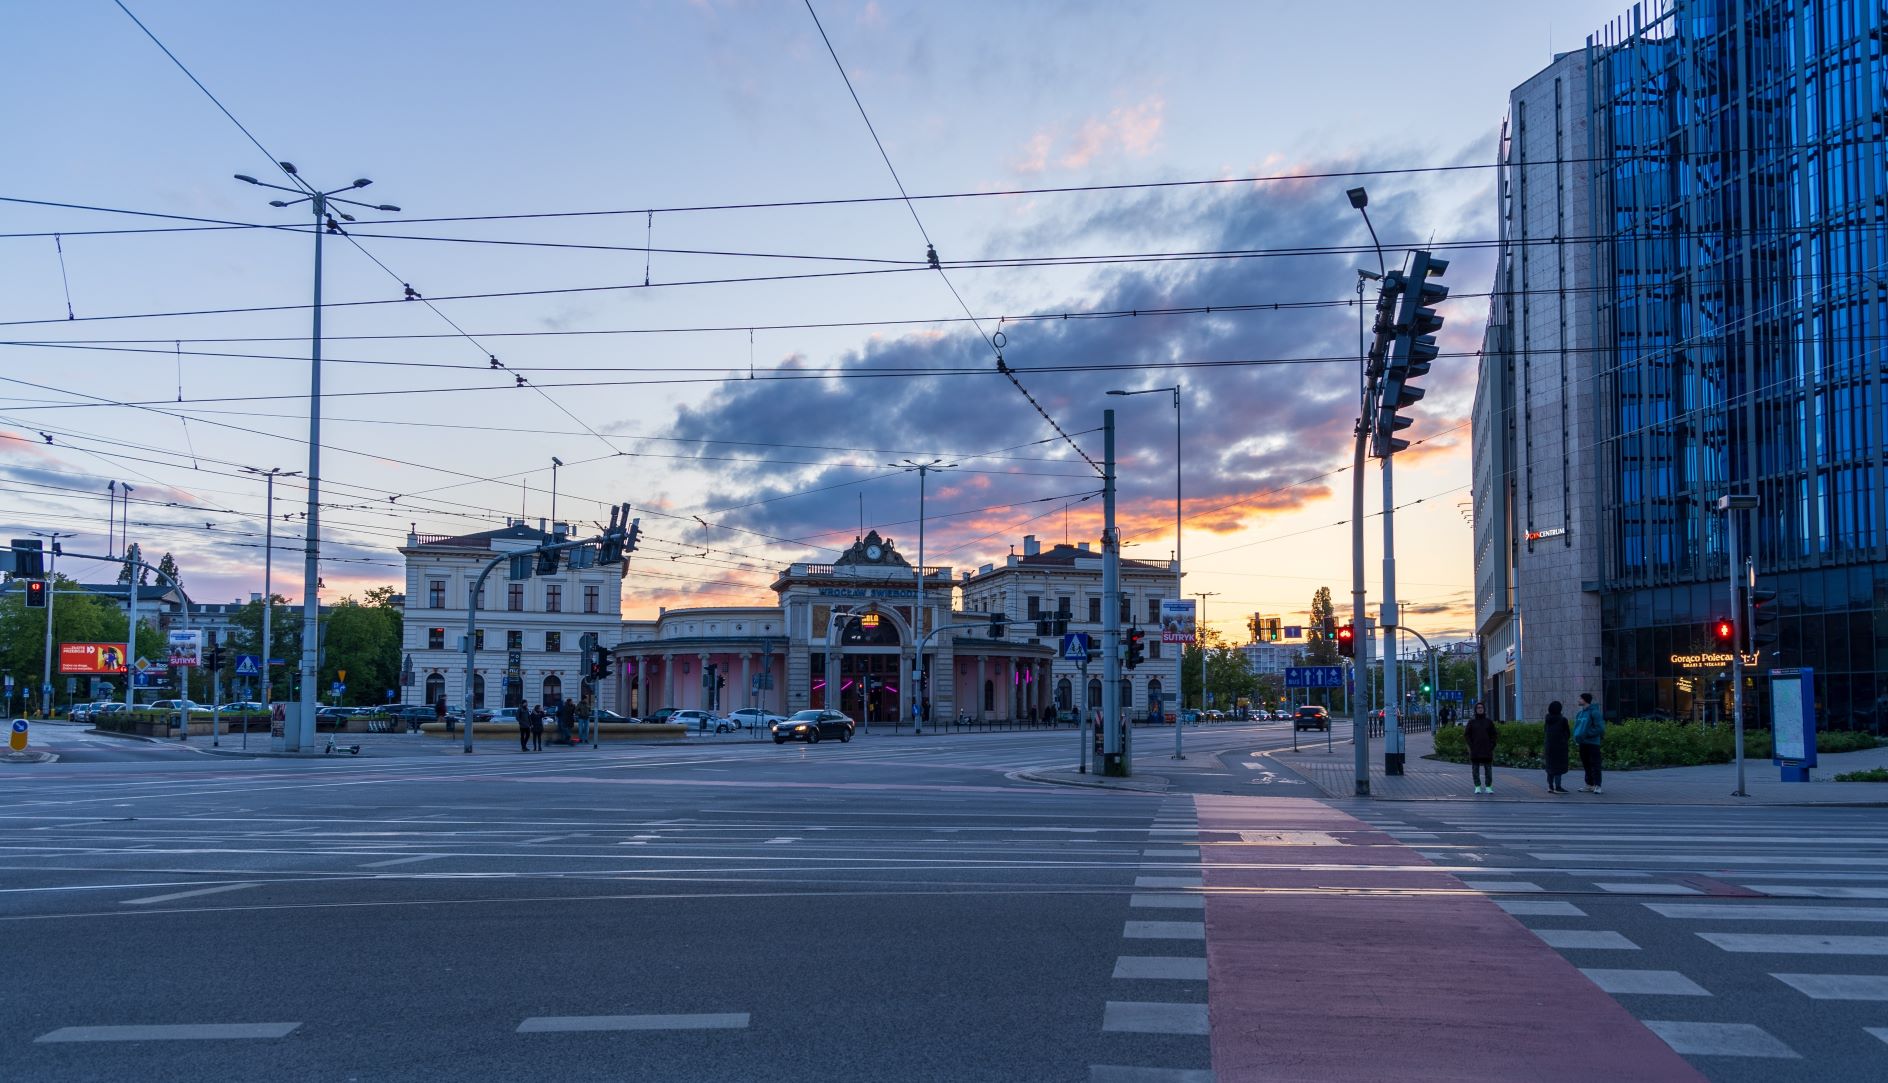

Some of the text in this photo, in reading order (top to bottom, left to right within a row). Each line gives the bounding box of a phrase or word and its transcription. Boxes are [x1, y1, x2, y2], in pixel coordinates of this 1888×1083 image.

[818, 587, 929, 597] WROCŁAW ŚWIEBODZI
[1163, 633, 1195, 641] SUTRYK
[1670, 655, 1701, 663] Gorąco
